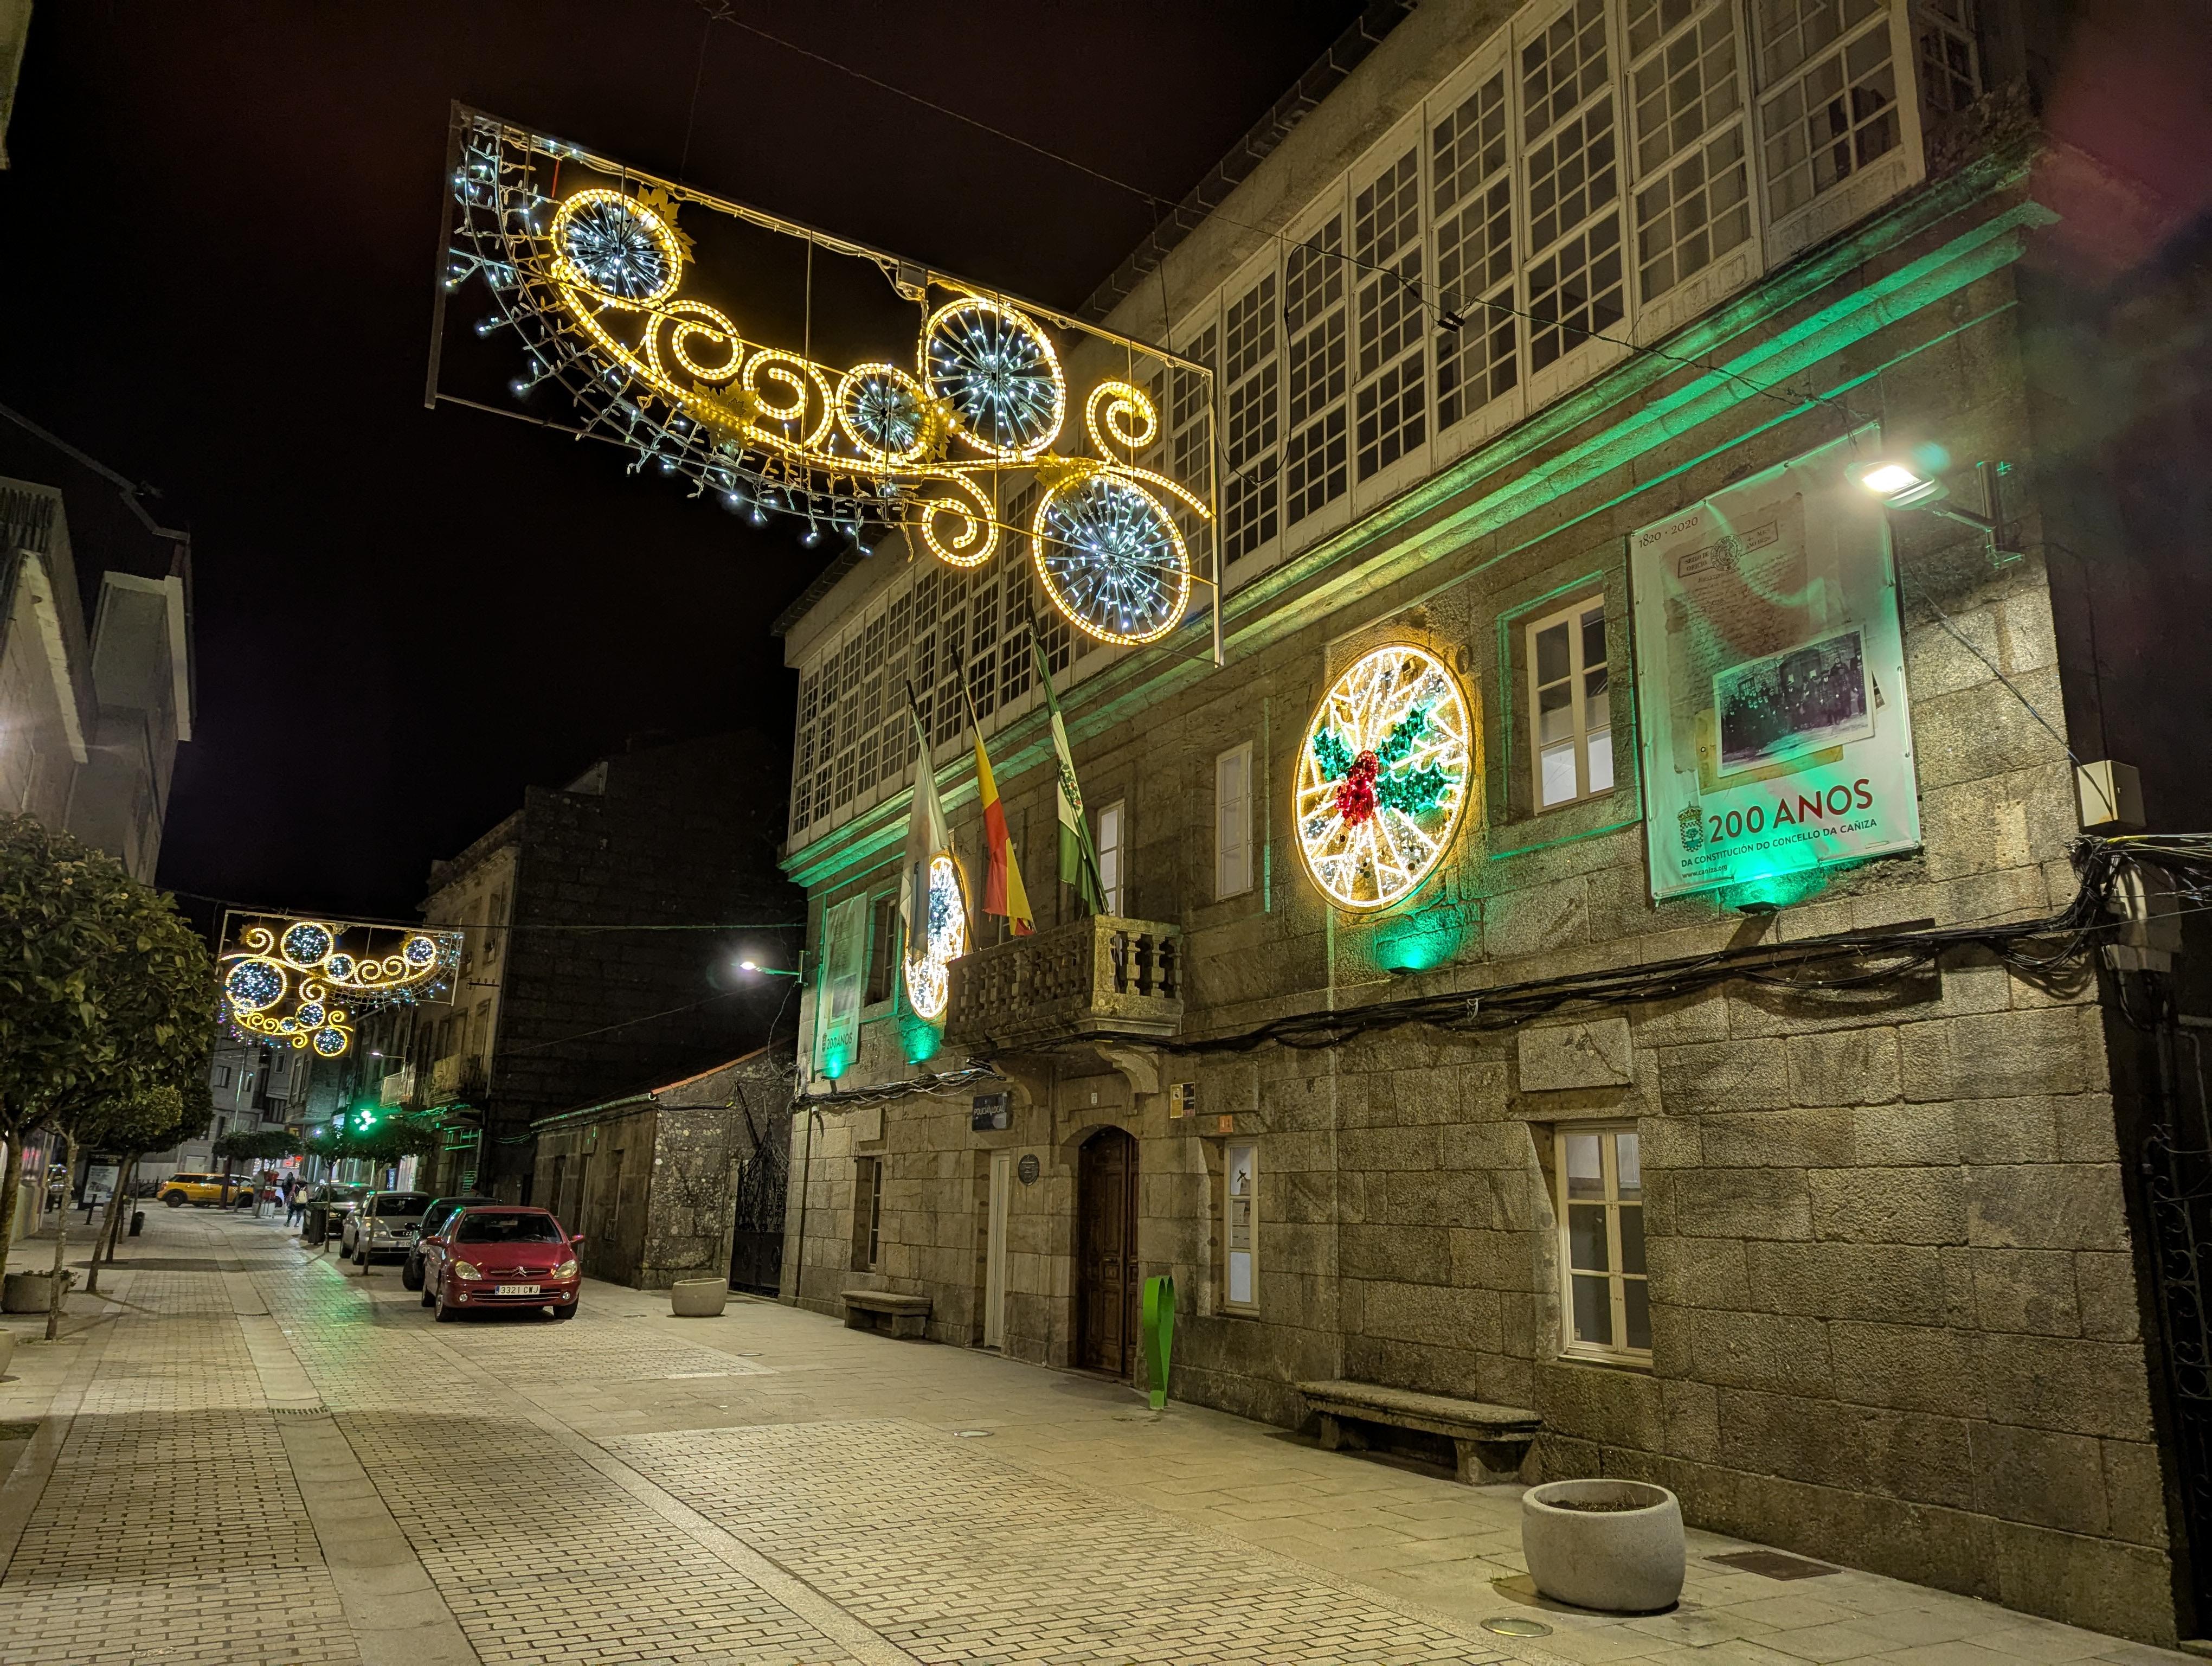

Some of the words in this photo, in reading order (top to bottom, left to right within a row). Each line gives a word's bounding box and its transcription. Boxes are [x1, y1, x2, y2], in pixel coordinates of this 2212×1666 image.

[1639, 532, 1661, 548] 1820
[1670, 517, 1698, 535] 2020
[1708, 805, 1764, 843] 200
[1773, 778, 1873, 829] ANOS
[1681, 858, 1693, 868] DA
[1694, 843, 1753, 864] CONSTITUCIÓN
[1756, 841, 1770, 850] DO
[1772, 830, 1821, 847] CONCELLO
[1823, 827, 1837, 836] DA
[1840, 818, 1877, 833] CAÑIZA
[1682, 864, 1727, 878] www.caniza.org
[827, 1037, 837, 1050] 200
[837, 1032, 853, 1047] ANOS
